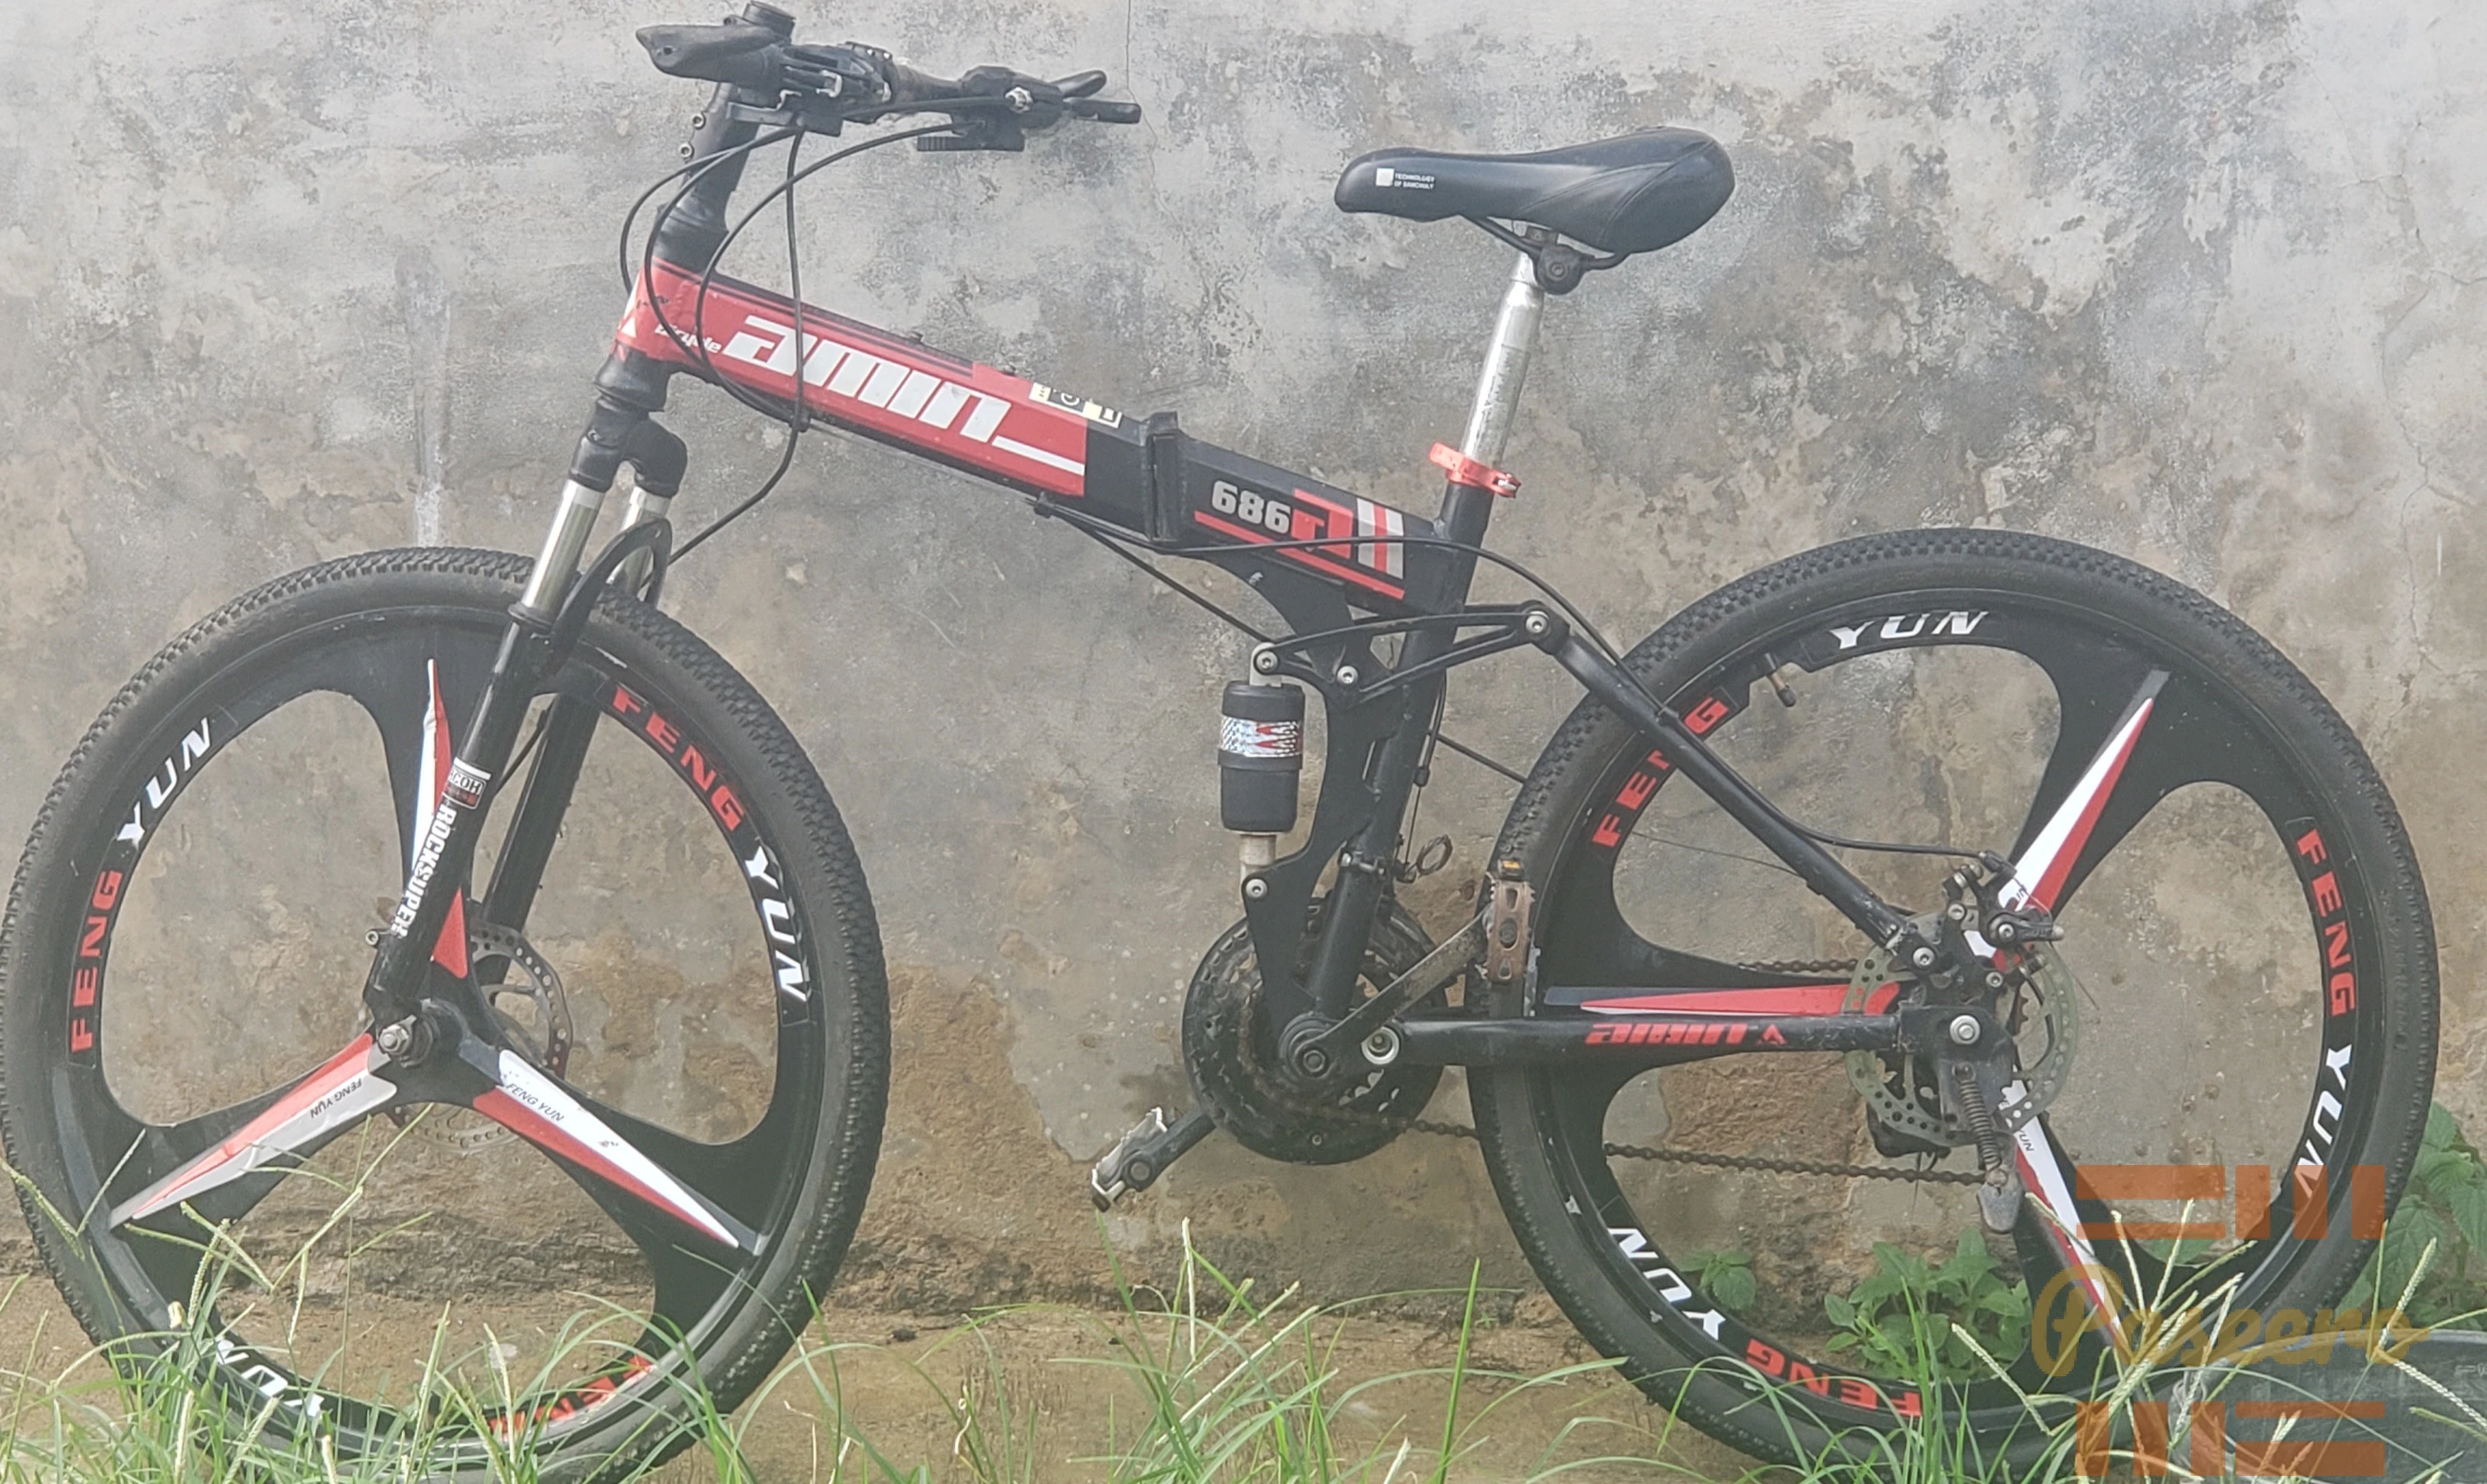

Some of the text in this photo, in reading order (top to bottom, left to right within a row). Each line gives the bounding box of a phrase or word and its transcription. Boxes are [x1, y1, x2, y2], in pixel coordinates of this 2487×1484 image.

[1211, 480, 1292, 534] 686
[1829, 610, 1989, 650] YUN
[116, 717, 211, 849] YUN
[611, 684, 745, 831] FENG
[71, 868, 123, 1053] FENG
[743, 845, 811, 1003] YUN
[2296, 828, 2357, 1017] FENG
[309, 1077, 363, 1119] FENG YUN
[506, 1082, 565, 1122] FENG YUN
[2294, 1043, 2353, 1200] YUN
[1607, 1226, 1726, 1341] YUN
[1745, 1337, 1922, 1418] FENG
